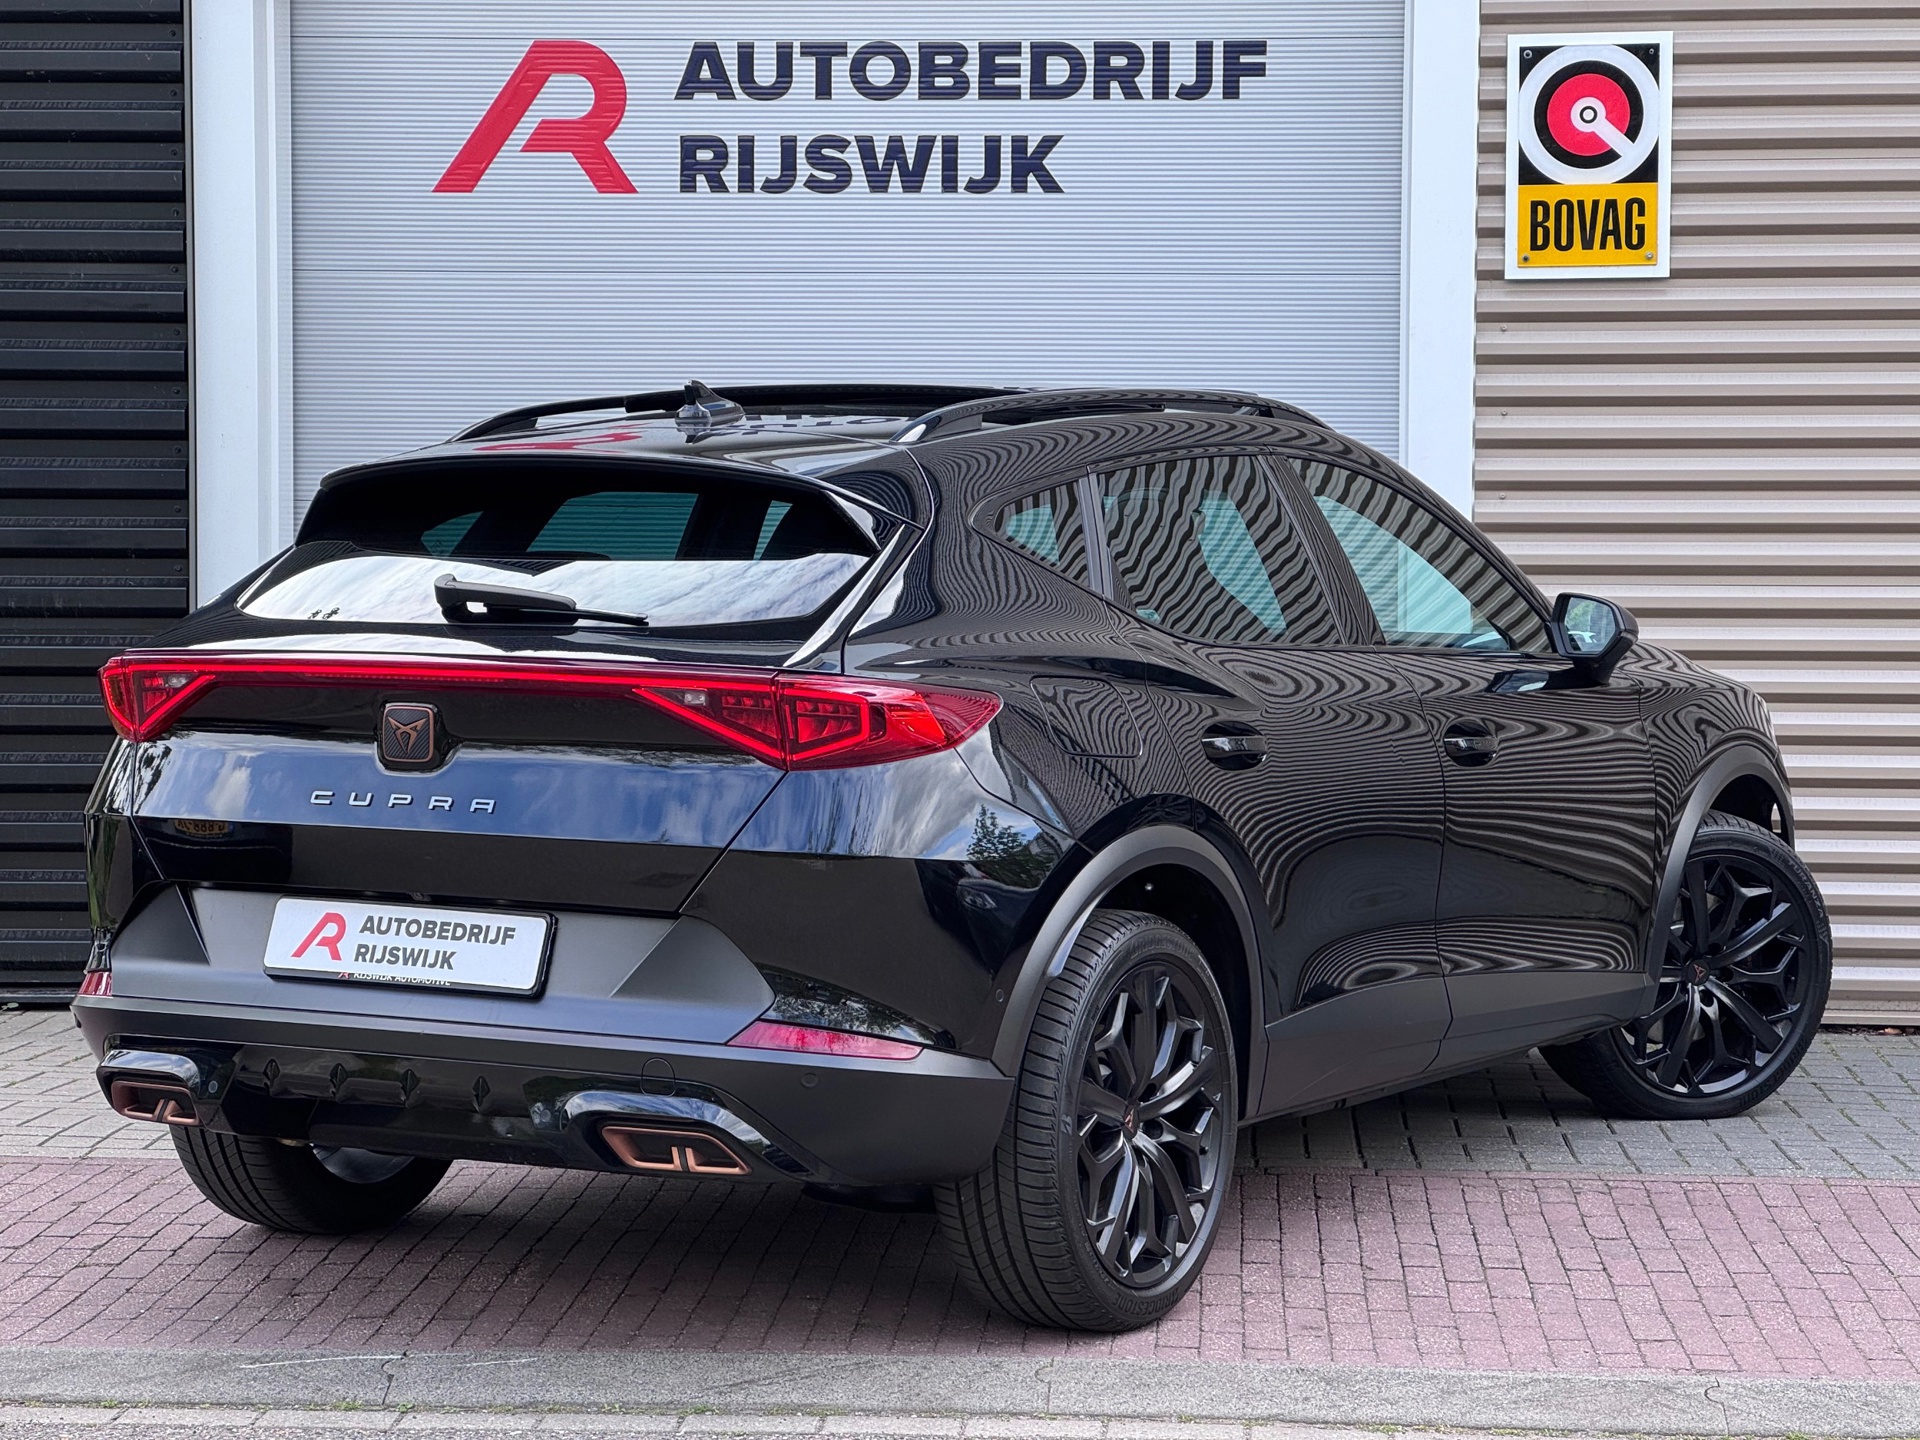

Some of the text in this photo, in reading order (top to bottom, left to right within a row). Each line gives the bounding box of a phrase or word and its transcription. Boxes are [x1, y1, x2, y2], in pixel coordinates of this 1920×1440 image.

[673, 40, 1268, 101] AUTOBEDRIJF
[678, 134, 1065, 194] RIJSWIJK
[1529, 197, 1646, 252] BOVAG
[309, 789, 497, 815] CUPRA
[1787, 858, 1824, 919] TURANZA
[358, 915, 517, 946] AUTOBEDRIJF
[353, 943, 459, 971] RIJSWIJK
[1111, 1286, 1180, 1316] BRIDGESTONE
